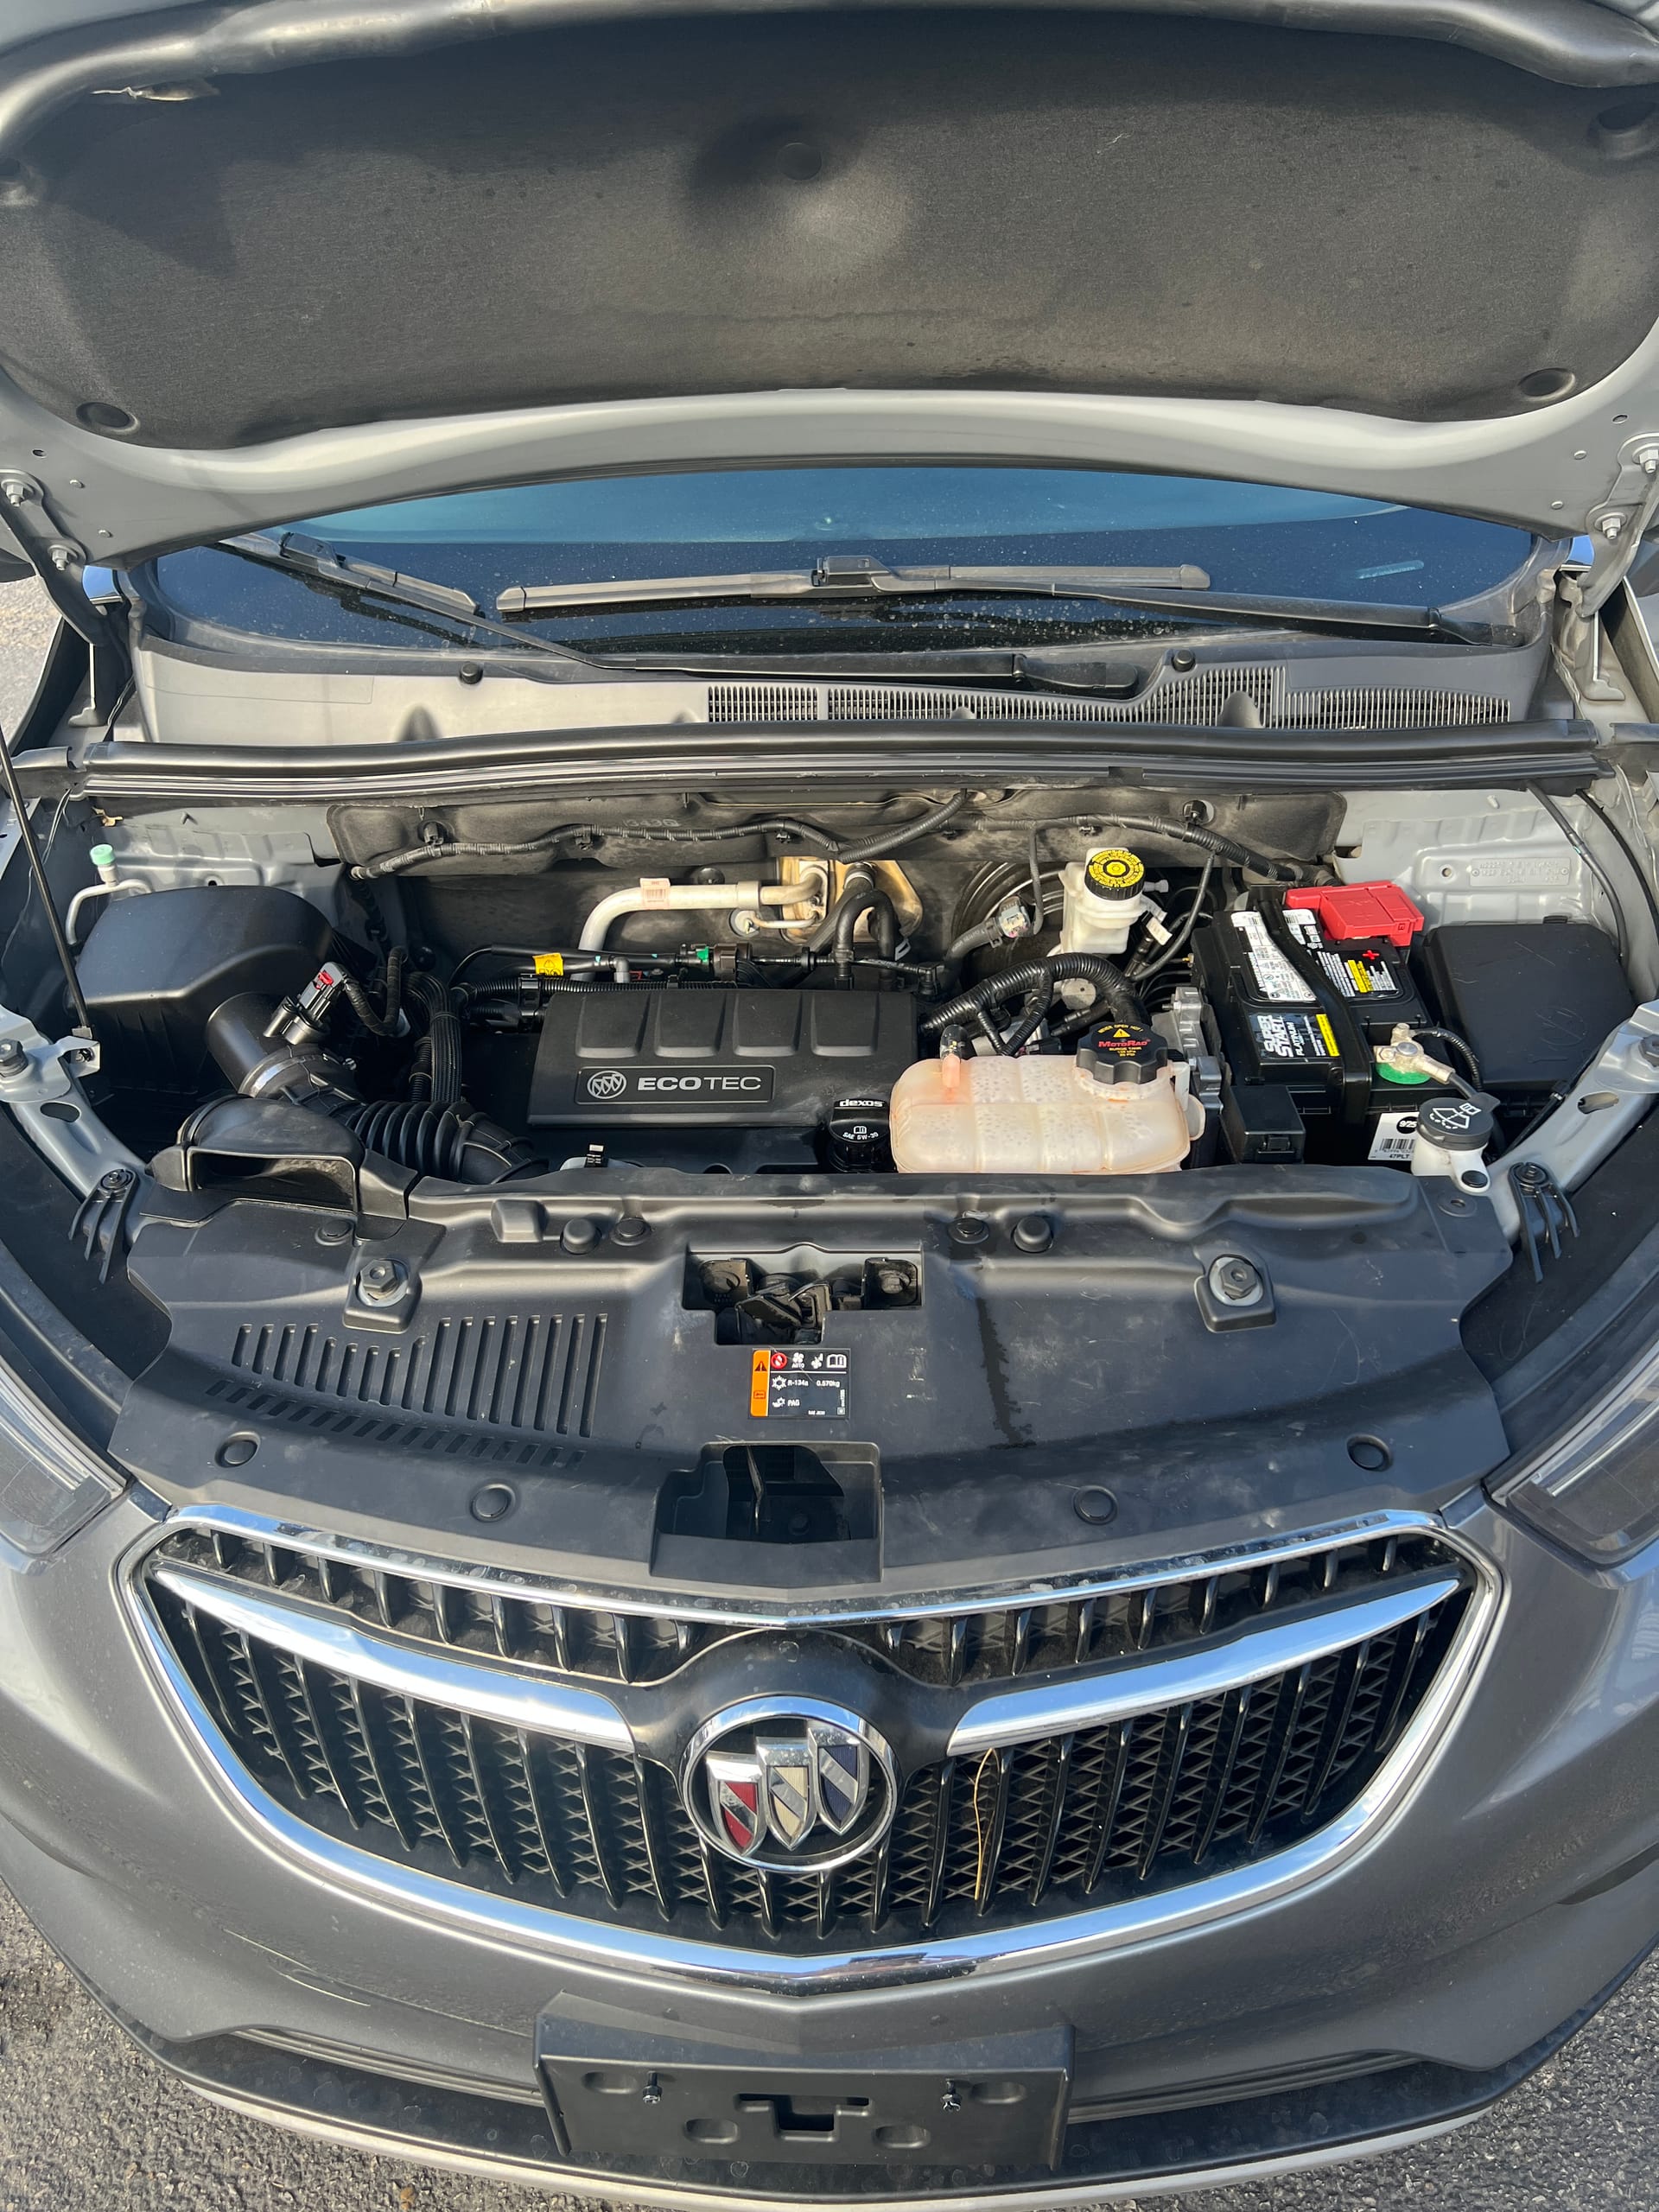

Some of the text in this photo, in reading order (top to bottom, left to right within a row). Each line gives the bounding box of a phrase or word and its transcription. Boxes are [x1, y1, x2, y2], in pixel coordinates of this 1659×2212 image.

[1257, 1014, 1275, 1052] SUPER
[1271, 1015, 1294, 1058] START
[1287, 1021, 1306, 1057] PLATINUM
[638, 1077, 761, 1090] ECOTEC
[839, 1098, 885, 1107] dexos
[856, 1131, 879, 1141] 5W-30
